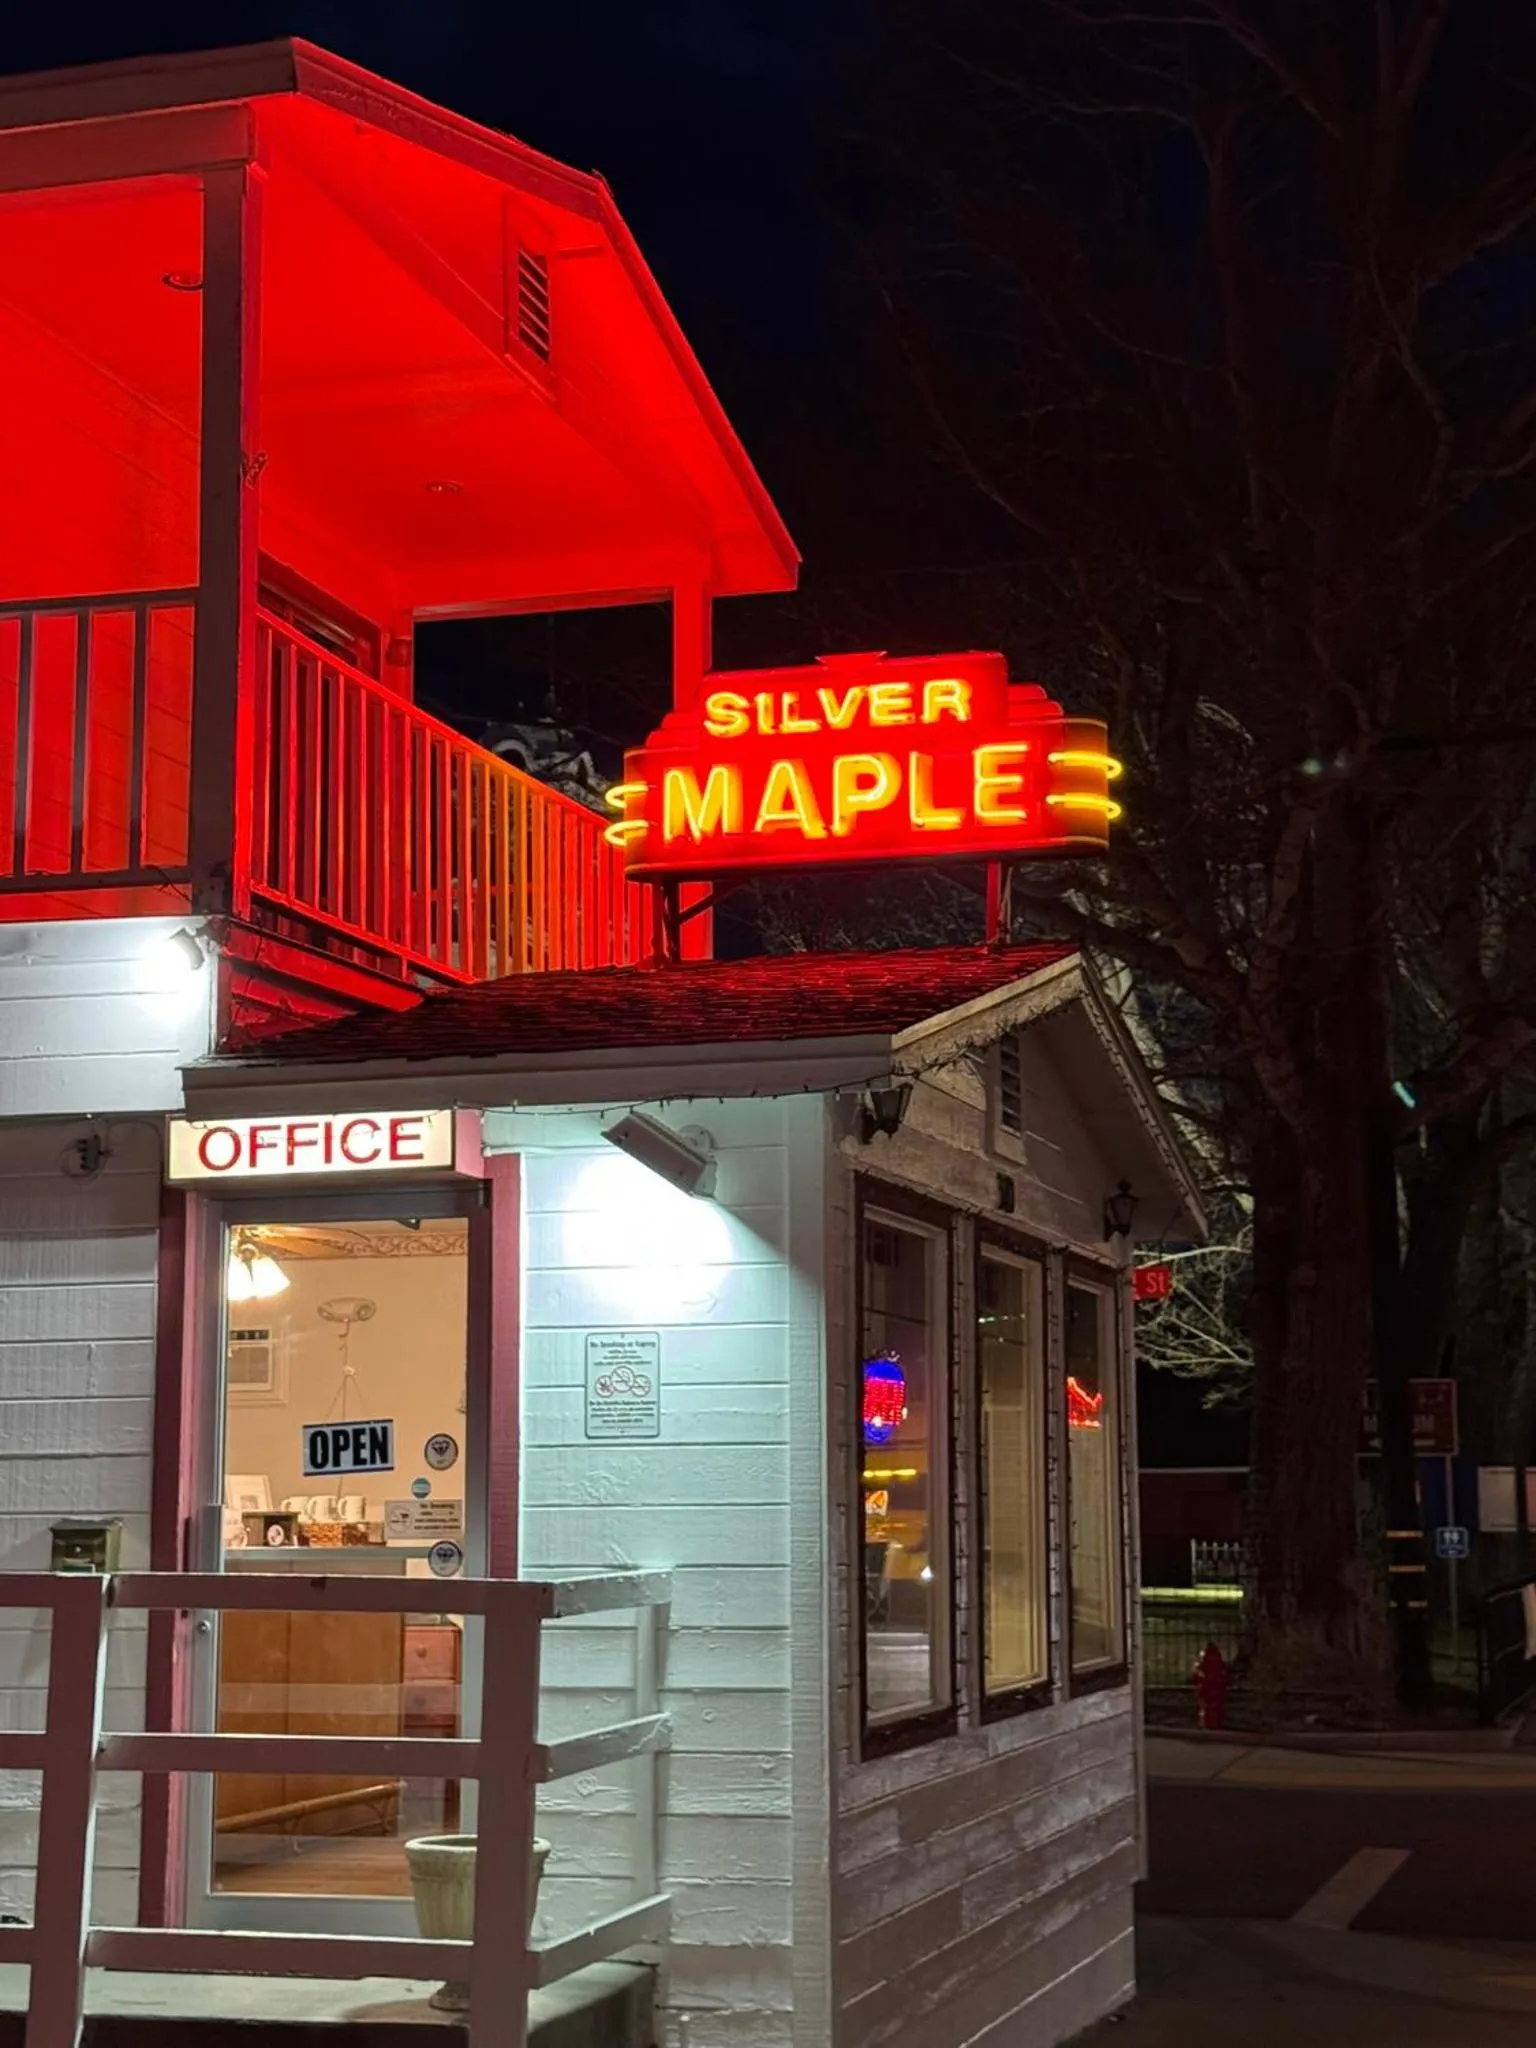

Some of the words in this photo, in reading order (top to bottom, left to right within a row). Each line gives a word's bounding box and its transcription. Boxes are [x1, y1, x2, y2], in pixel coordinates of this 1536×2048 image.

[704, 679, 973, 738] SILVER
[663, 743, 1031, 845] MAPLE
[197, 1116, 425, 1172] OFFICE
[1146, 1271, 1165, 1293] St
[308, 1425, 389, 1469] OPEN
